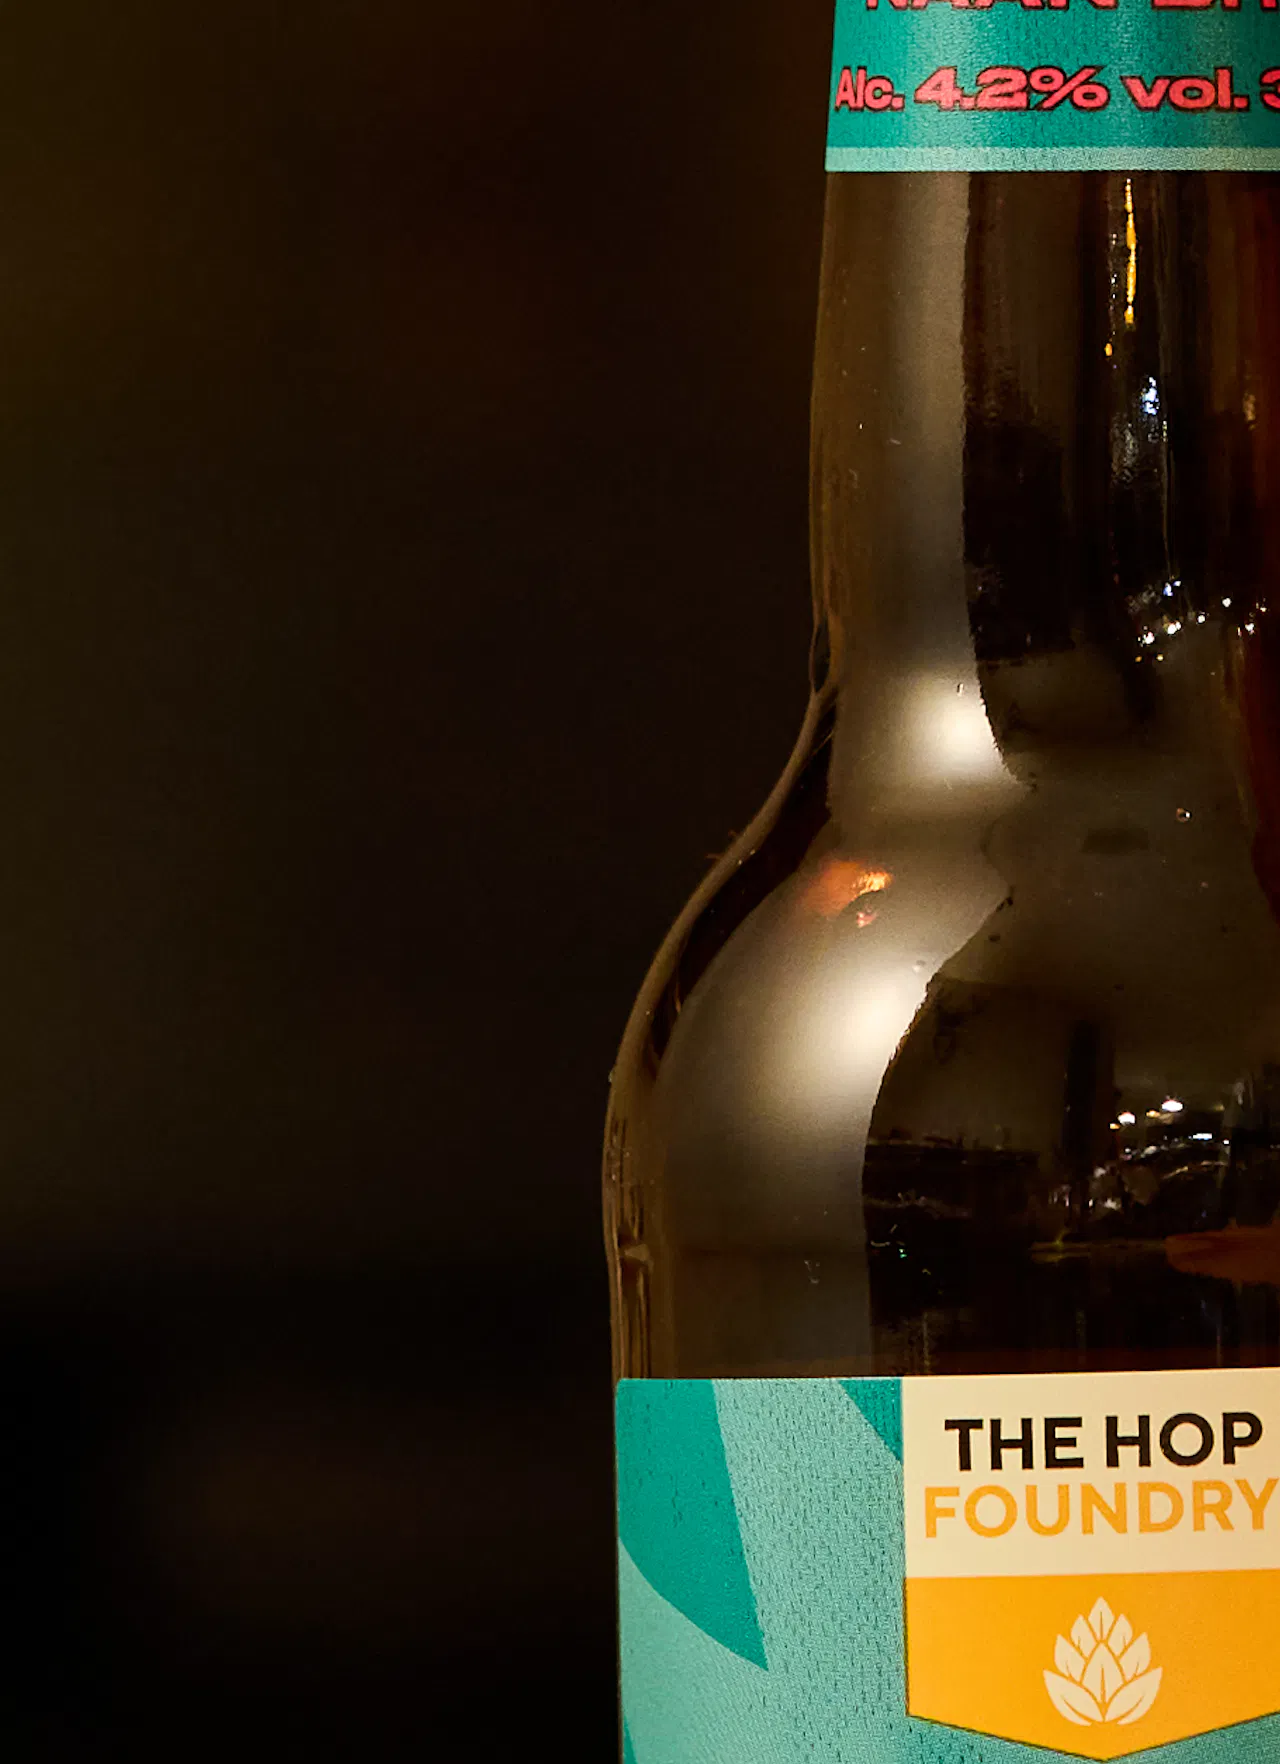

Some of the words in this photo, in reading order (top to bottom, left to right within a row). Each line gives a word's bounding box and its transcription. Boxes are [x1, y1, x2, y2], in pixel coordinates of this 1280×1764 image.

[835, 66, 905, 111] Alc.
[913, 65, 1111, 111] 4.2%
[1121, 66, 1249, 112] vol.
[944, 1415, 1085, 1472] THE
[1105, 1411, 1264, 1468] HOP
[923, 1477, 1280, 1539] FOUNDRY
